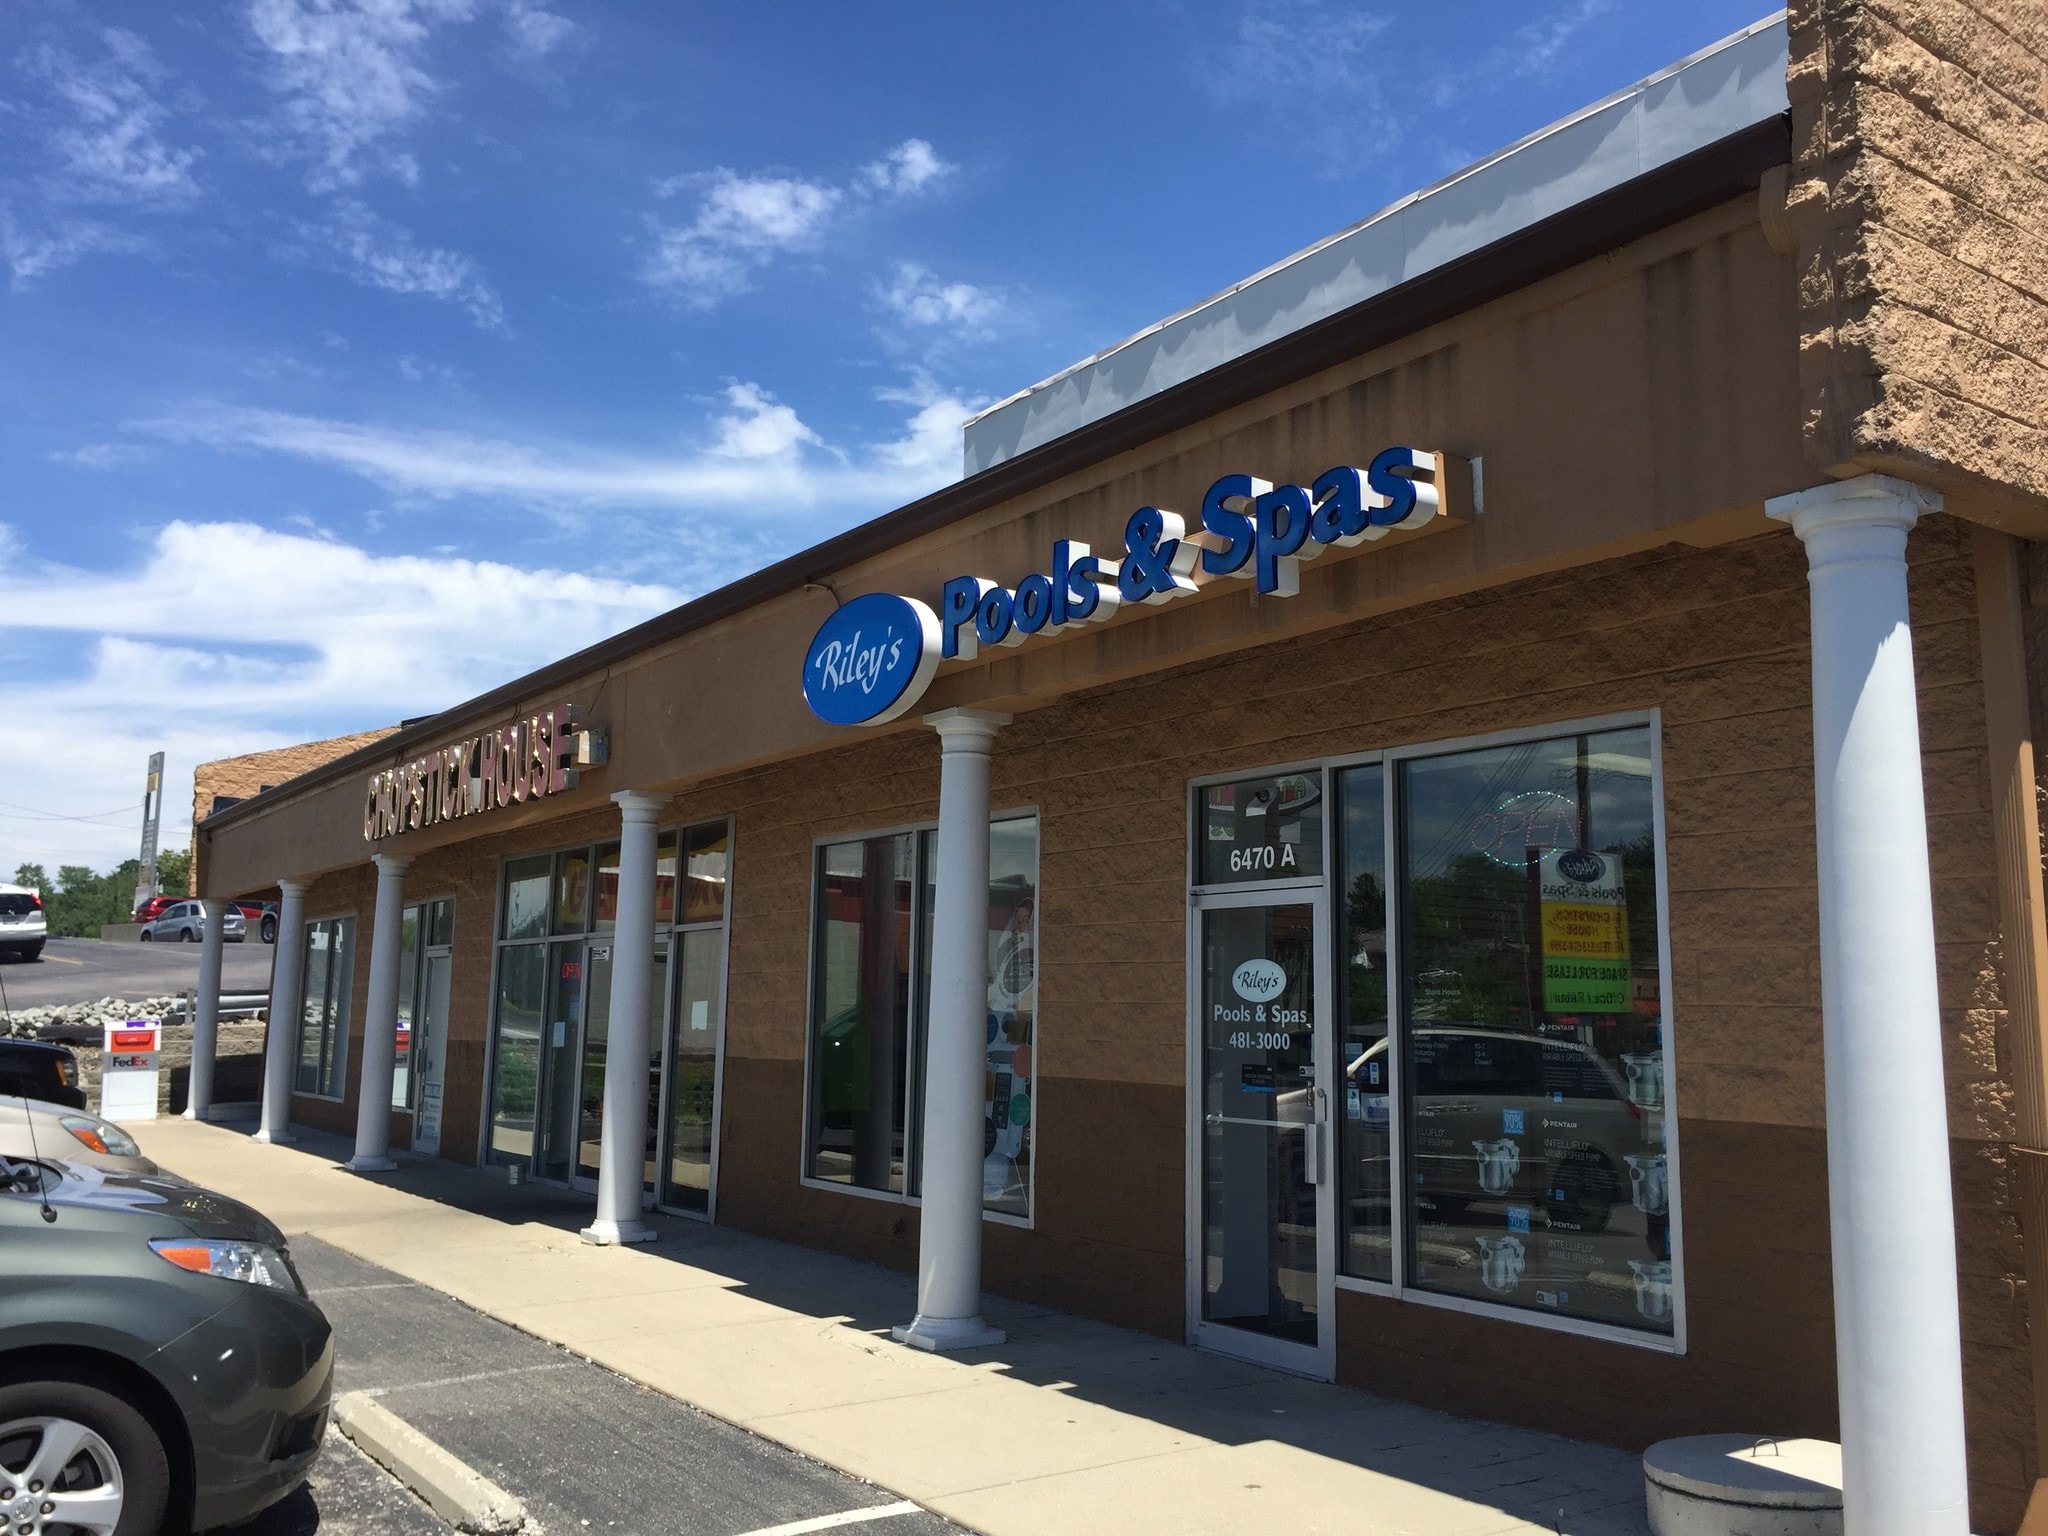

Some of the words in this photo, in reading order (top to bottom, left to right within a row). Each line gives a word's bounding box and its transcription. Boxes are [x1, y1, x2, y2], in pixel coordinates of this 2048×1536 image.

[941, 539, 1116, 661] Pools
[1118, 506, 1195, 604] &
[1200, 446, 1437, 598] Spas
[815, 628, 903, 694] Riley's
[364, 742, 477, 842] CHOPSTICK
[479, 703, 576, 814] HOUSE
[1230, 844, 1275, 872] 6470
[1280, 843, 1296, 867] A
[1237, 970, 1279, 994] Riley's
[1213, 1004, 1251, 1023] Pools
[1255, 1004, 1267, 1023] &
[1271, 1004, 1308, 1028] Spas
[1547, 1024, 1575, 1032] PENTAIR
[1229, 1031, 1291, 1050] 481-3000
[113, 1056, 148, 1067] FedEx
[1504, 1114, 1523, 1129] 90%
[1549, 1120, 1578, 1129] PENTAIR
[1553, 1220, 1581, 1231] PENTAIR
